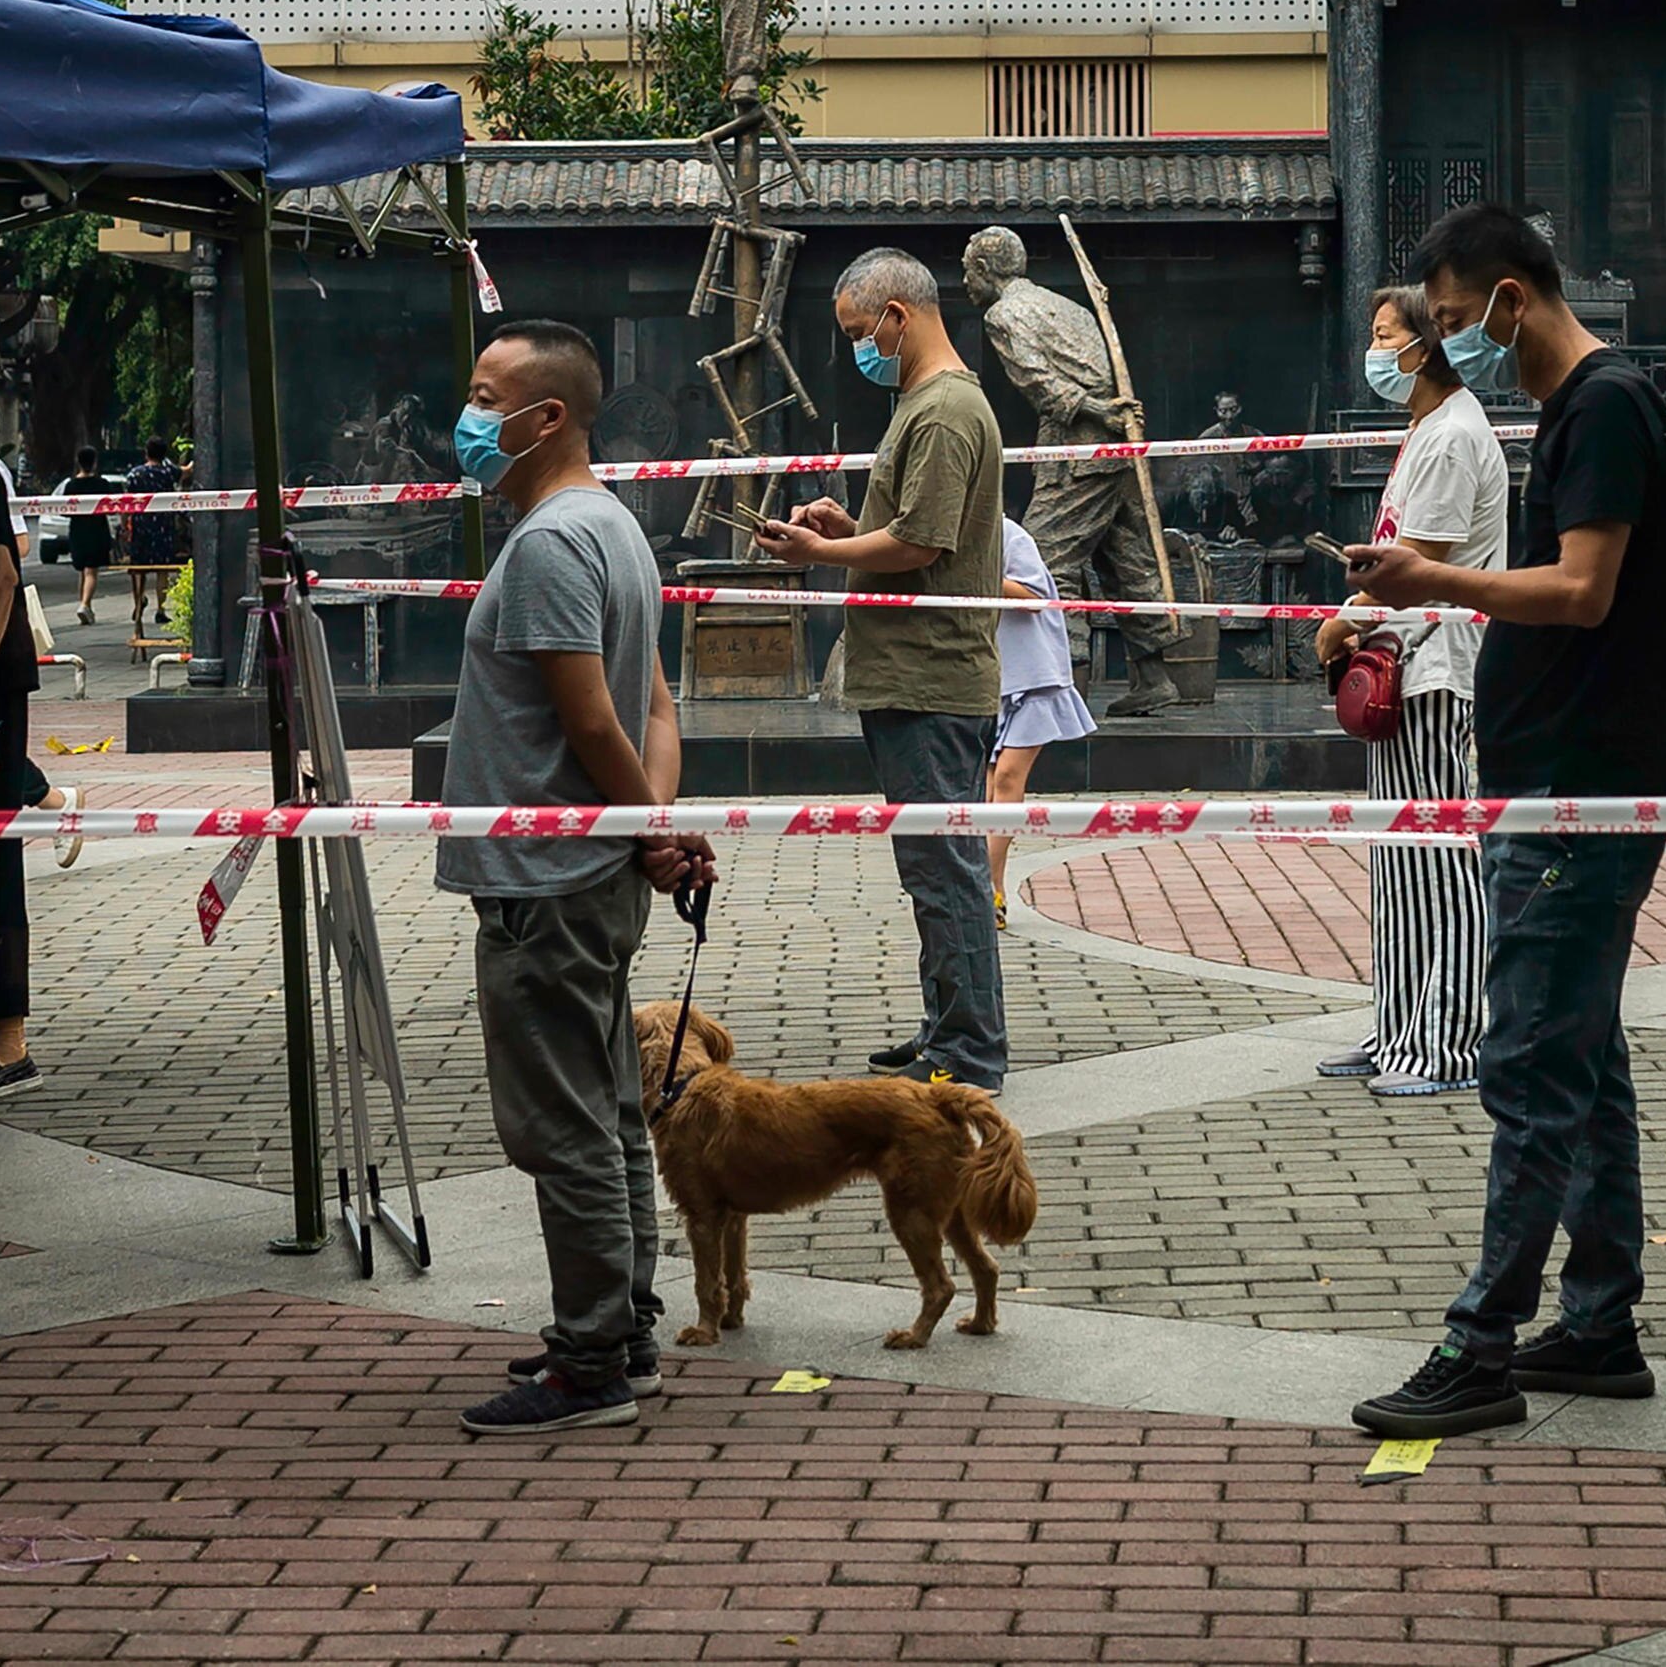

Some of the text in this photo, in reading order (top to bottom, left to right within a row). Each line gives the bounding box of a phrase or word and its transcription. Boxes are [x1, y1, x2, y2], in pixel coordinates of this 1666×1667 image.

[19, 505, 78, 515] CAUTION
[171, 499, 230, 509] CAUTION
[322, 494, 381, 503] CAUTION
[1016, 451, 1075, 461] CAUTION
[1099, 447, 1142, 457] SAFE
[1171, 443, 1231, 453] CAUTION
[1253, 439, 1298, 449] SAFE
[1327, 435, 1387, 446] CAUTION
[215, 810, 289, 833] 安全
[349, 810, 454, 832] 注意
[509, 808, 584, 832] 安全
[646, 808, 751, 829] 注意
[807, 805, 883, 829] 安全
[946, 805, 1051, 827] 注意
[1108, 803, 1184, 826] 安全
[1248, 803, 1354, 825] 注意
[1412, 802, 1488, 825] 安全
[1553, 800, 1661, 822] 注意
